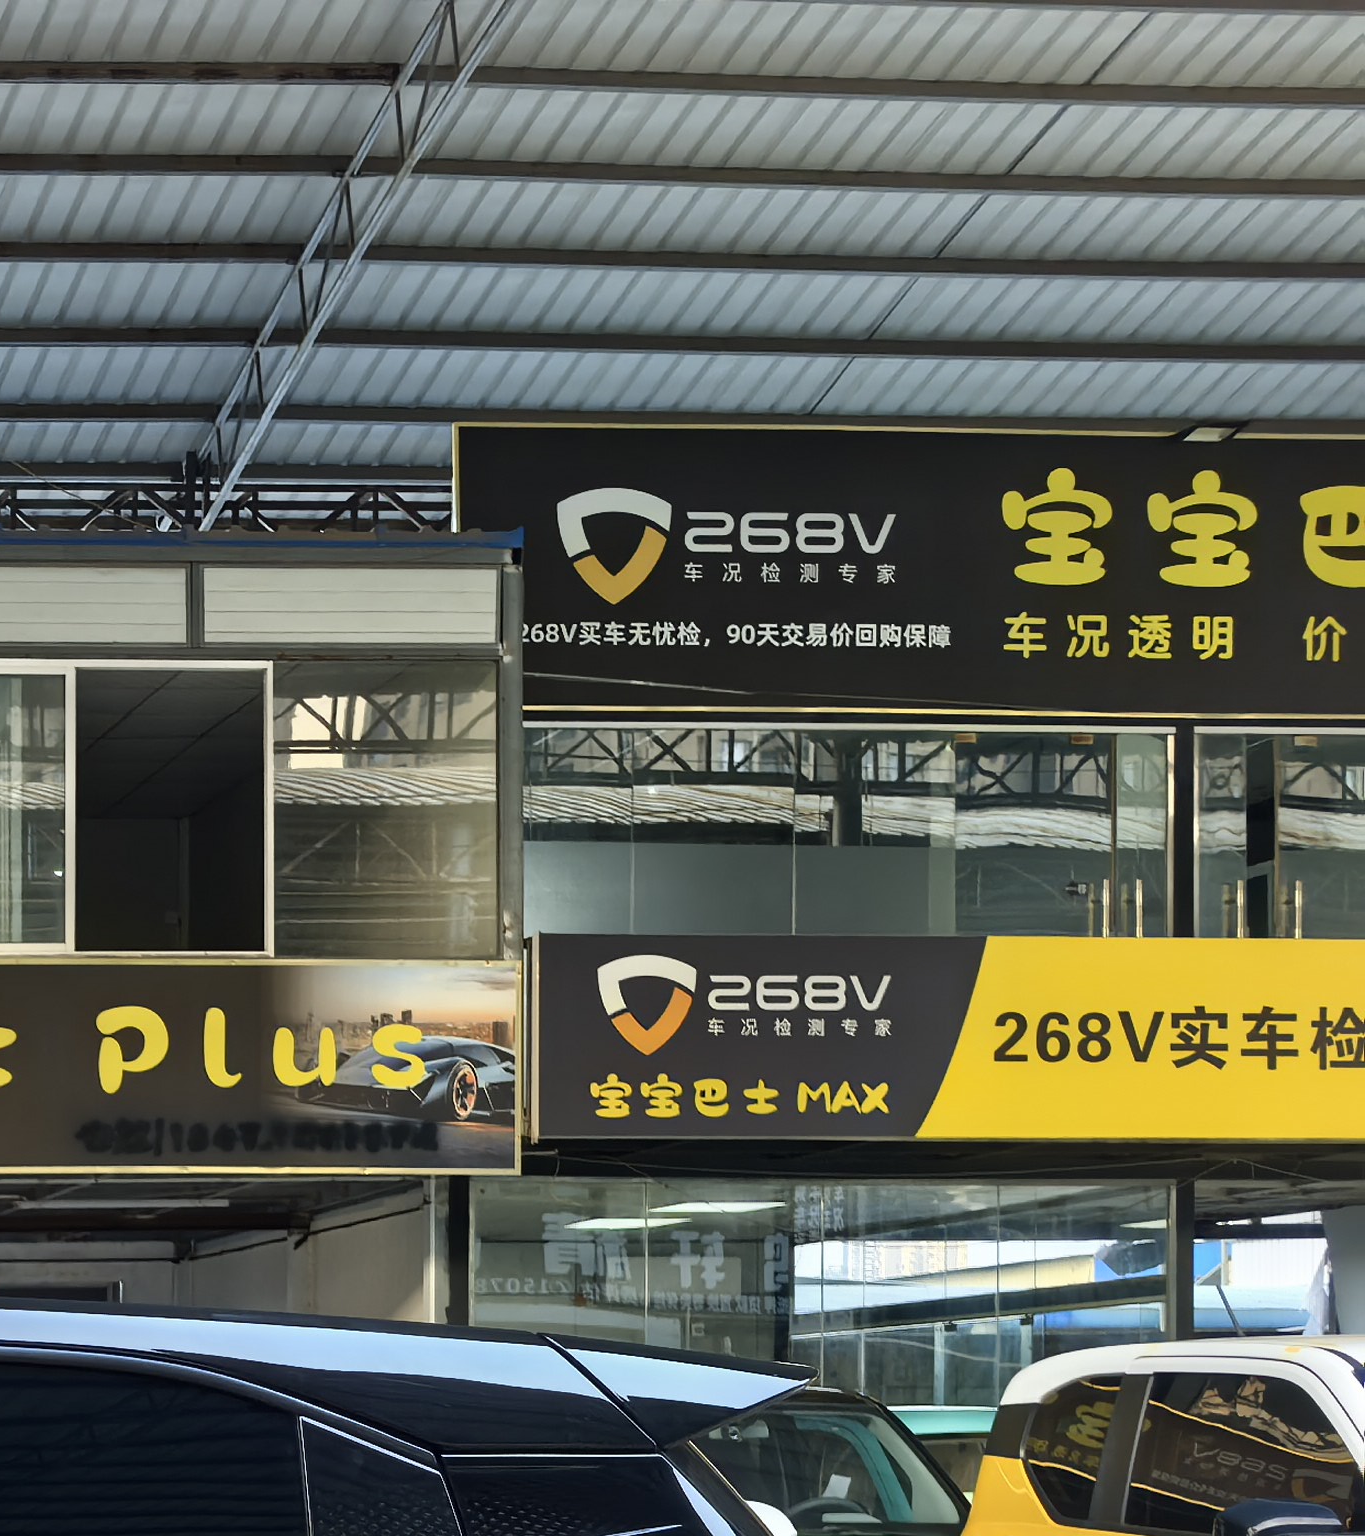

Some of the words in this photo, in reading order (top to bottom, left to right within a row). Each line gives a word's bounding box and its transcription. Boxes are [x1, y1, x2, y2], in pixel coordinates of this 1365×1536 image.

[684, 511, 897, 555] 268V
[684, 562, 897, 585] 车况检测专家
[1004, 612, 1235, 661] 车况透明
[1302, 617, 1348, 663] 价
[707, 973, 892, 1012] 268V
[707, 1017, 892, 1038] 车况检测专家
[95, 1005, 427, 1095] Plus
[589, 1074, 780, 1119] 宝宝巴士
[796, 1080, 891, 1115] MAX
